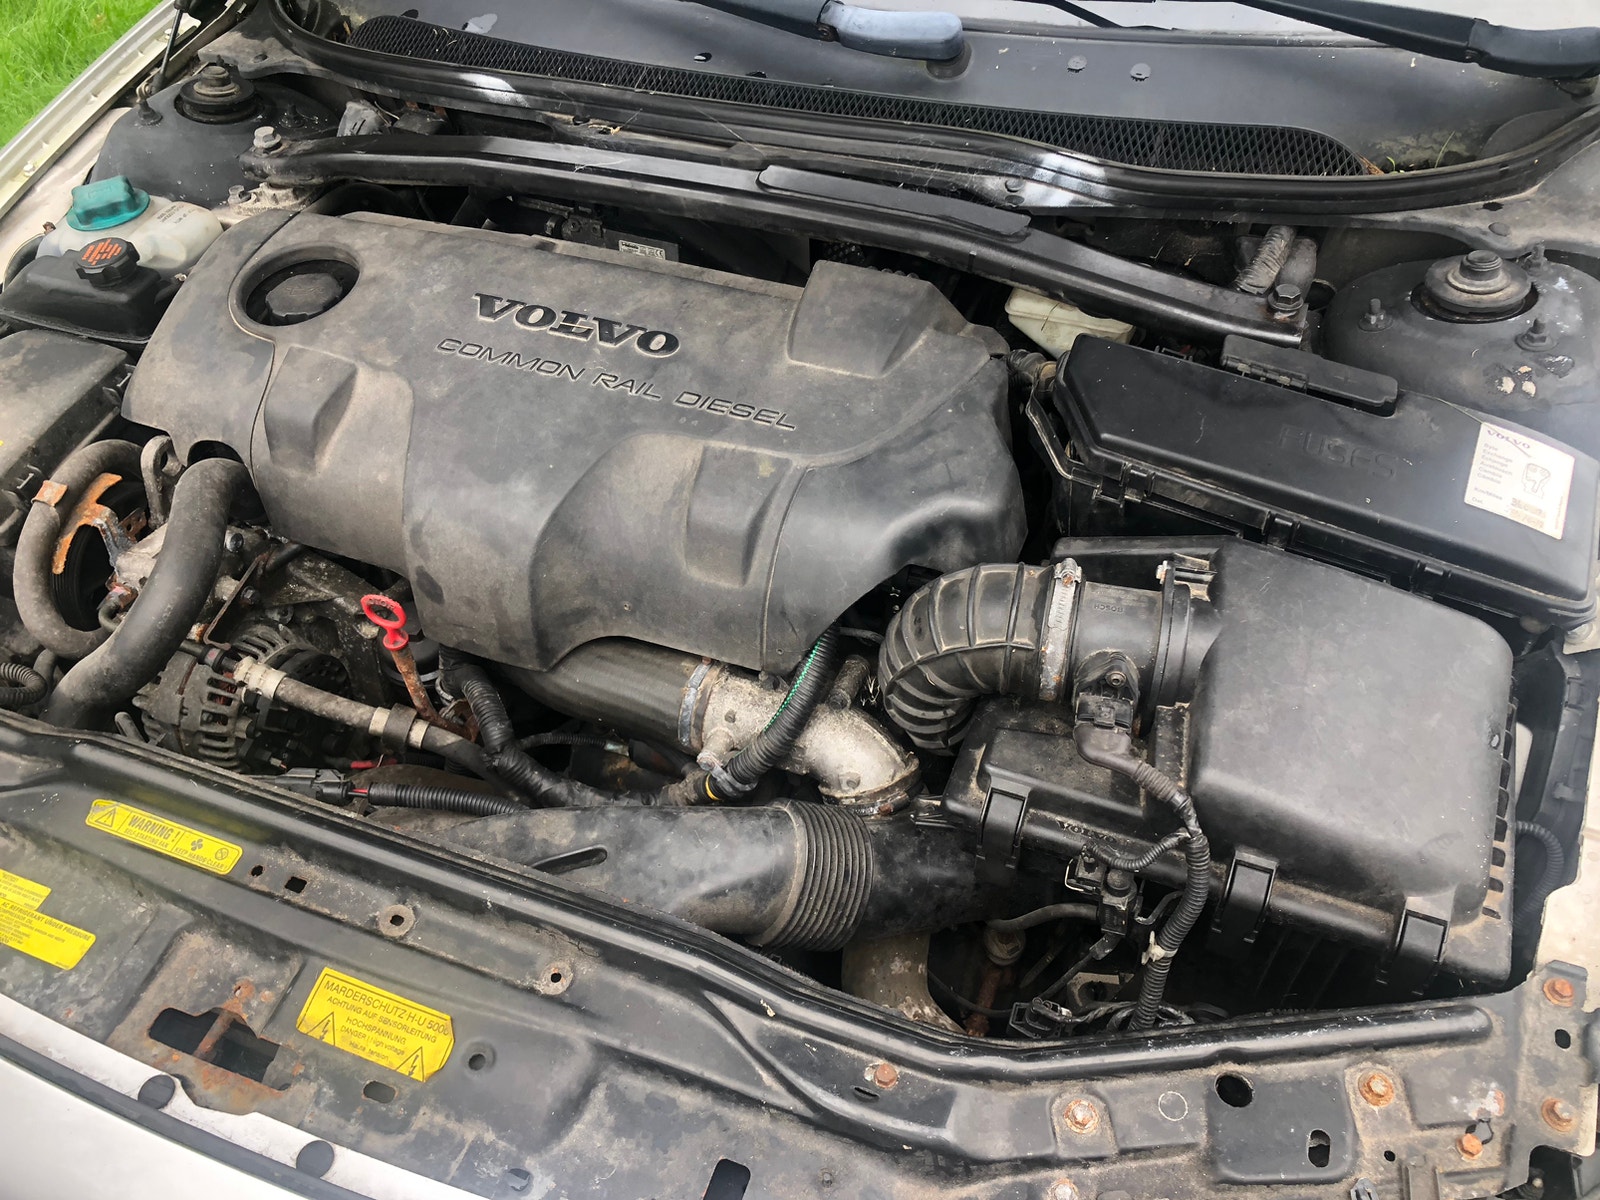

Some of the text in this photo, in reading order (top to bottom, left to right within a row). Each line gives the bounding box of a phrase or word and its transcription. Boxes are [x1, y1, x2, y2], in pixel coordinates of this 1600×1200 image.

[475, 293, 679, 356] VOLVO
[437, 337, 796, 431] COMMON RAIL DIESEL
[1279, 425, 1396, 479] FUSES
[1487, 429, 1531, 449] VOLVO
[128, 814, 174, 840] WARNING
[327, 996, 362, 1015] ACHTUNG
[362, 1010, 378, 1020] AUF
[346, 1017, 406, 1045] HOCHSPANNUNG
